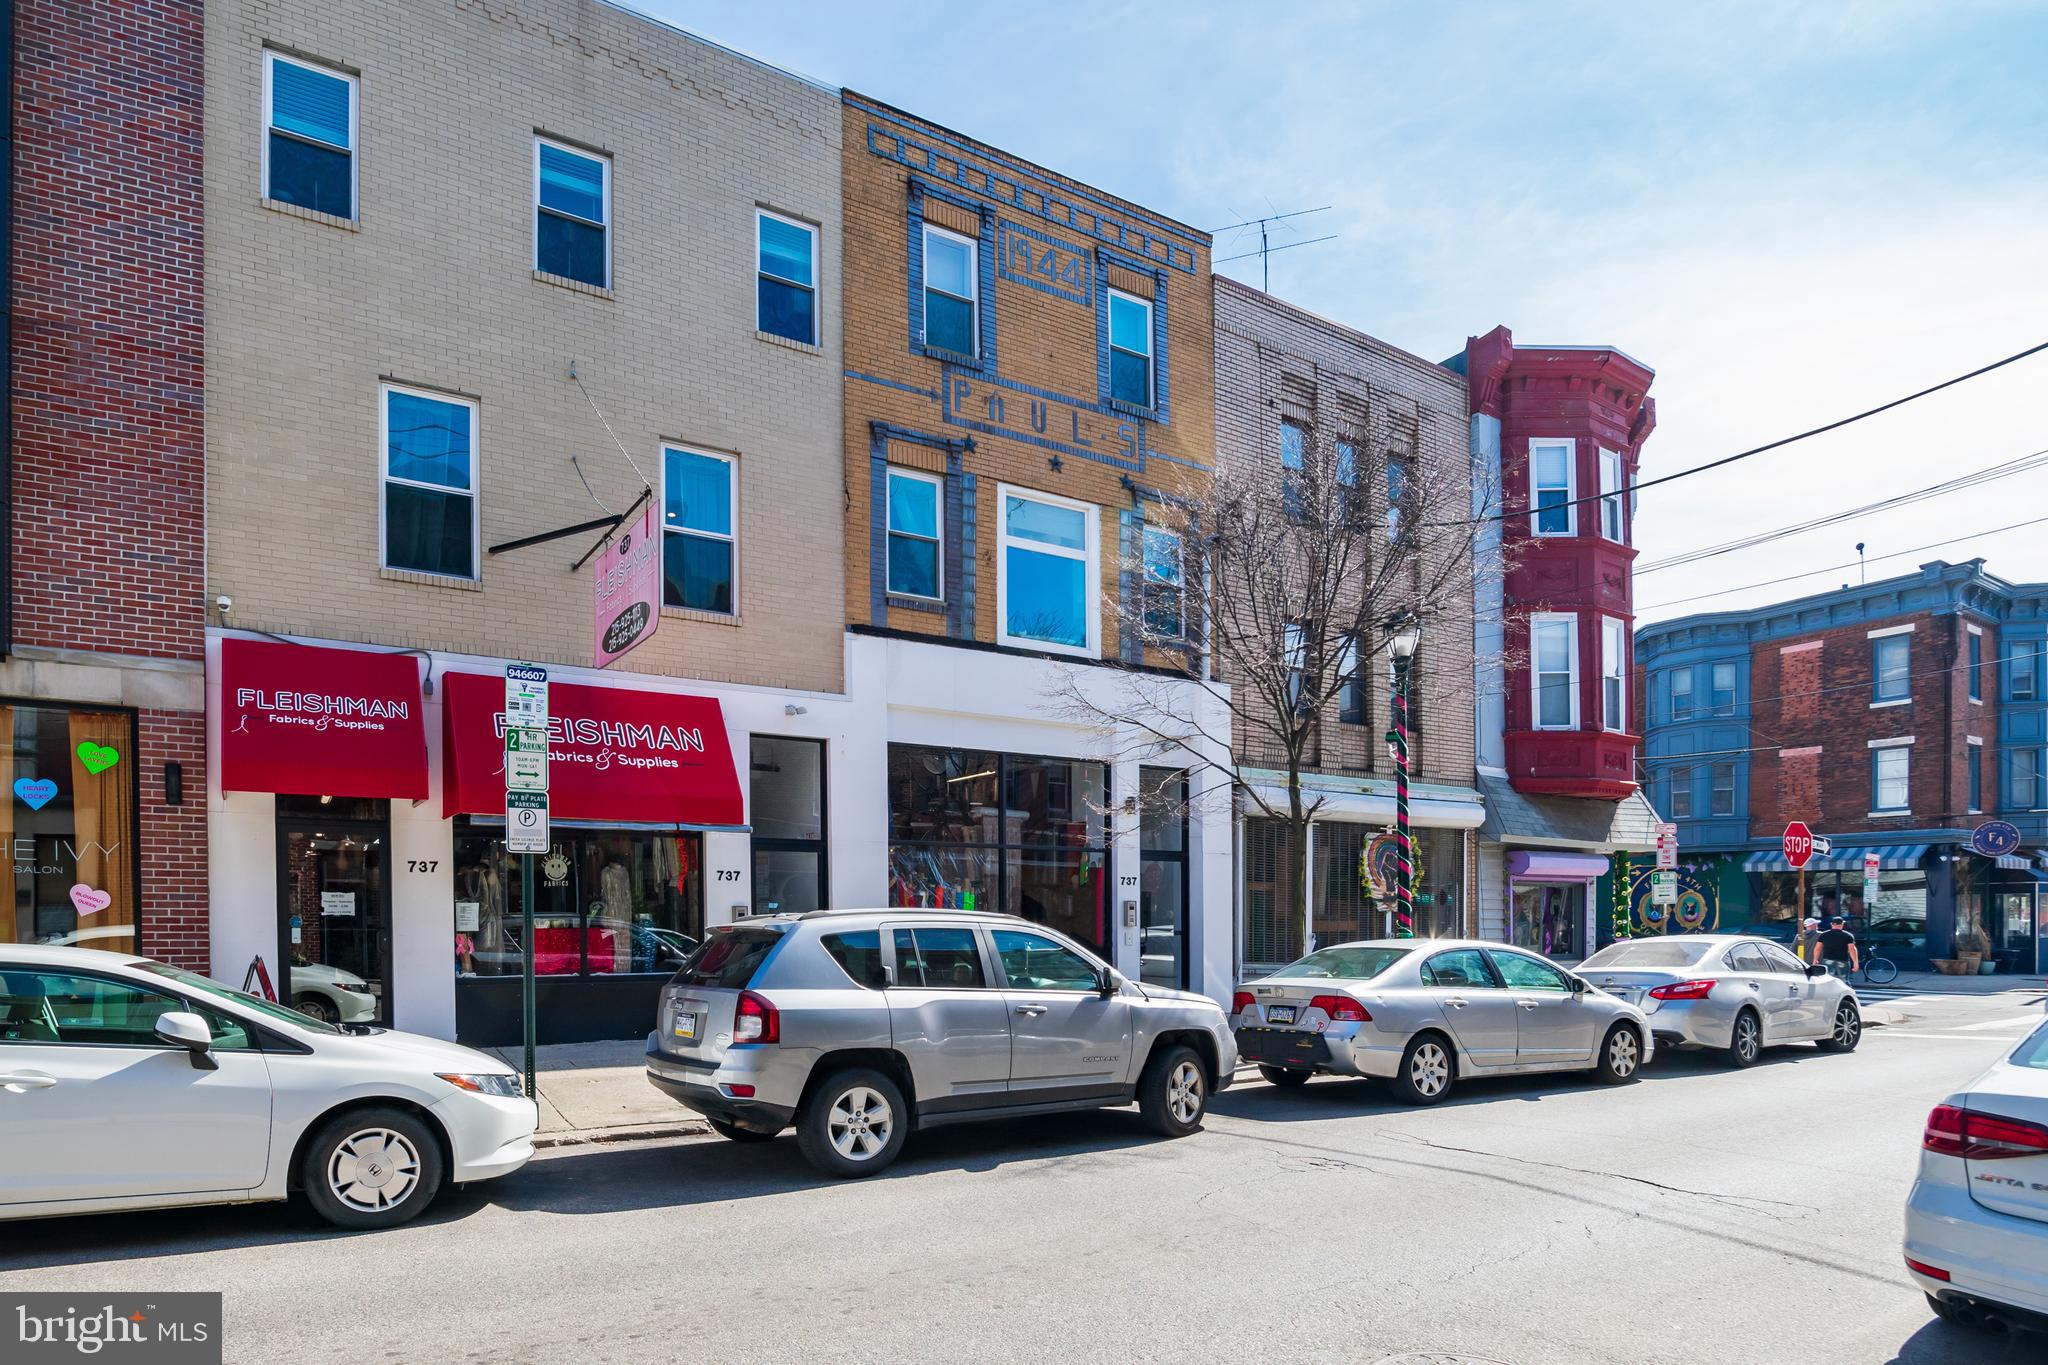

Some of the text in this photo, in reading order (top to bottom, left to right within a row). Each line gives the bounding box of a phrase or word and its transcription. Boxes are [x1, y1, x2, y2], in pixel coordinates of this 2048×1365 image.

[1009, 234, 1080, 290] 1944
[508, 668, 545, 681] 946607
[237, 688, 408, 720] FLEISHMAN
[269, 714, 385, 731] Fabrics & Supplies
[493, 712, 704, 752] FEISHMAN
[526, 733, 538, 742] HR
[510, 732, 518, 748] 2
[520, 742, 546, 752] PARKING
[547, 748, 679, 771] abrics & Supplies
[514, 801, 540, 809] PARKING
[530, 795, 547, 803] PLATE
[55, 839, 121, 863] IVY
[1785, 836, 1810, 854] STOP
[13, 865, 64, 875] SALON
[407, 861, 439, 873] 737
[716, 870, 741, 881] 737
[1120, 876, 1137, 886] 737
[1653, 874, 1660, 885] 2
[75, 890, 105, 905] BLOWOUT
[77, 898, 97, 909] QUEEN
[1975, 1173, 2025, 1188] JETTA
